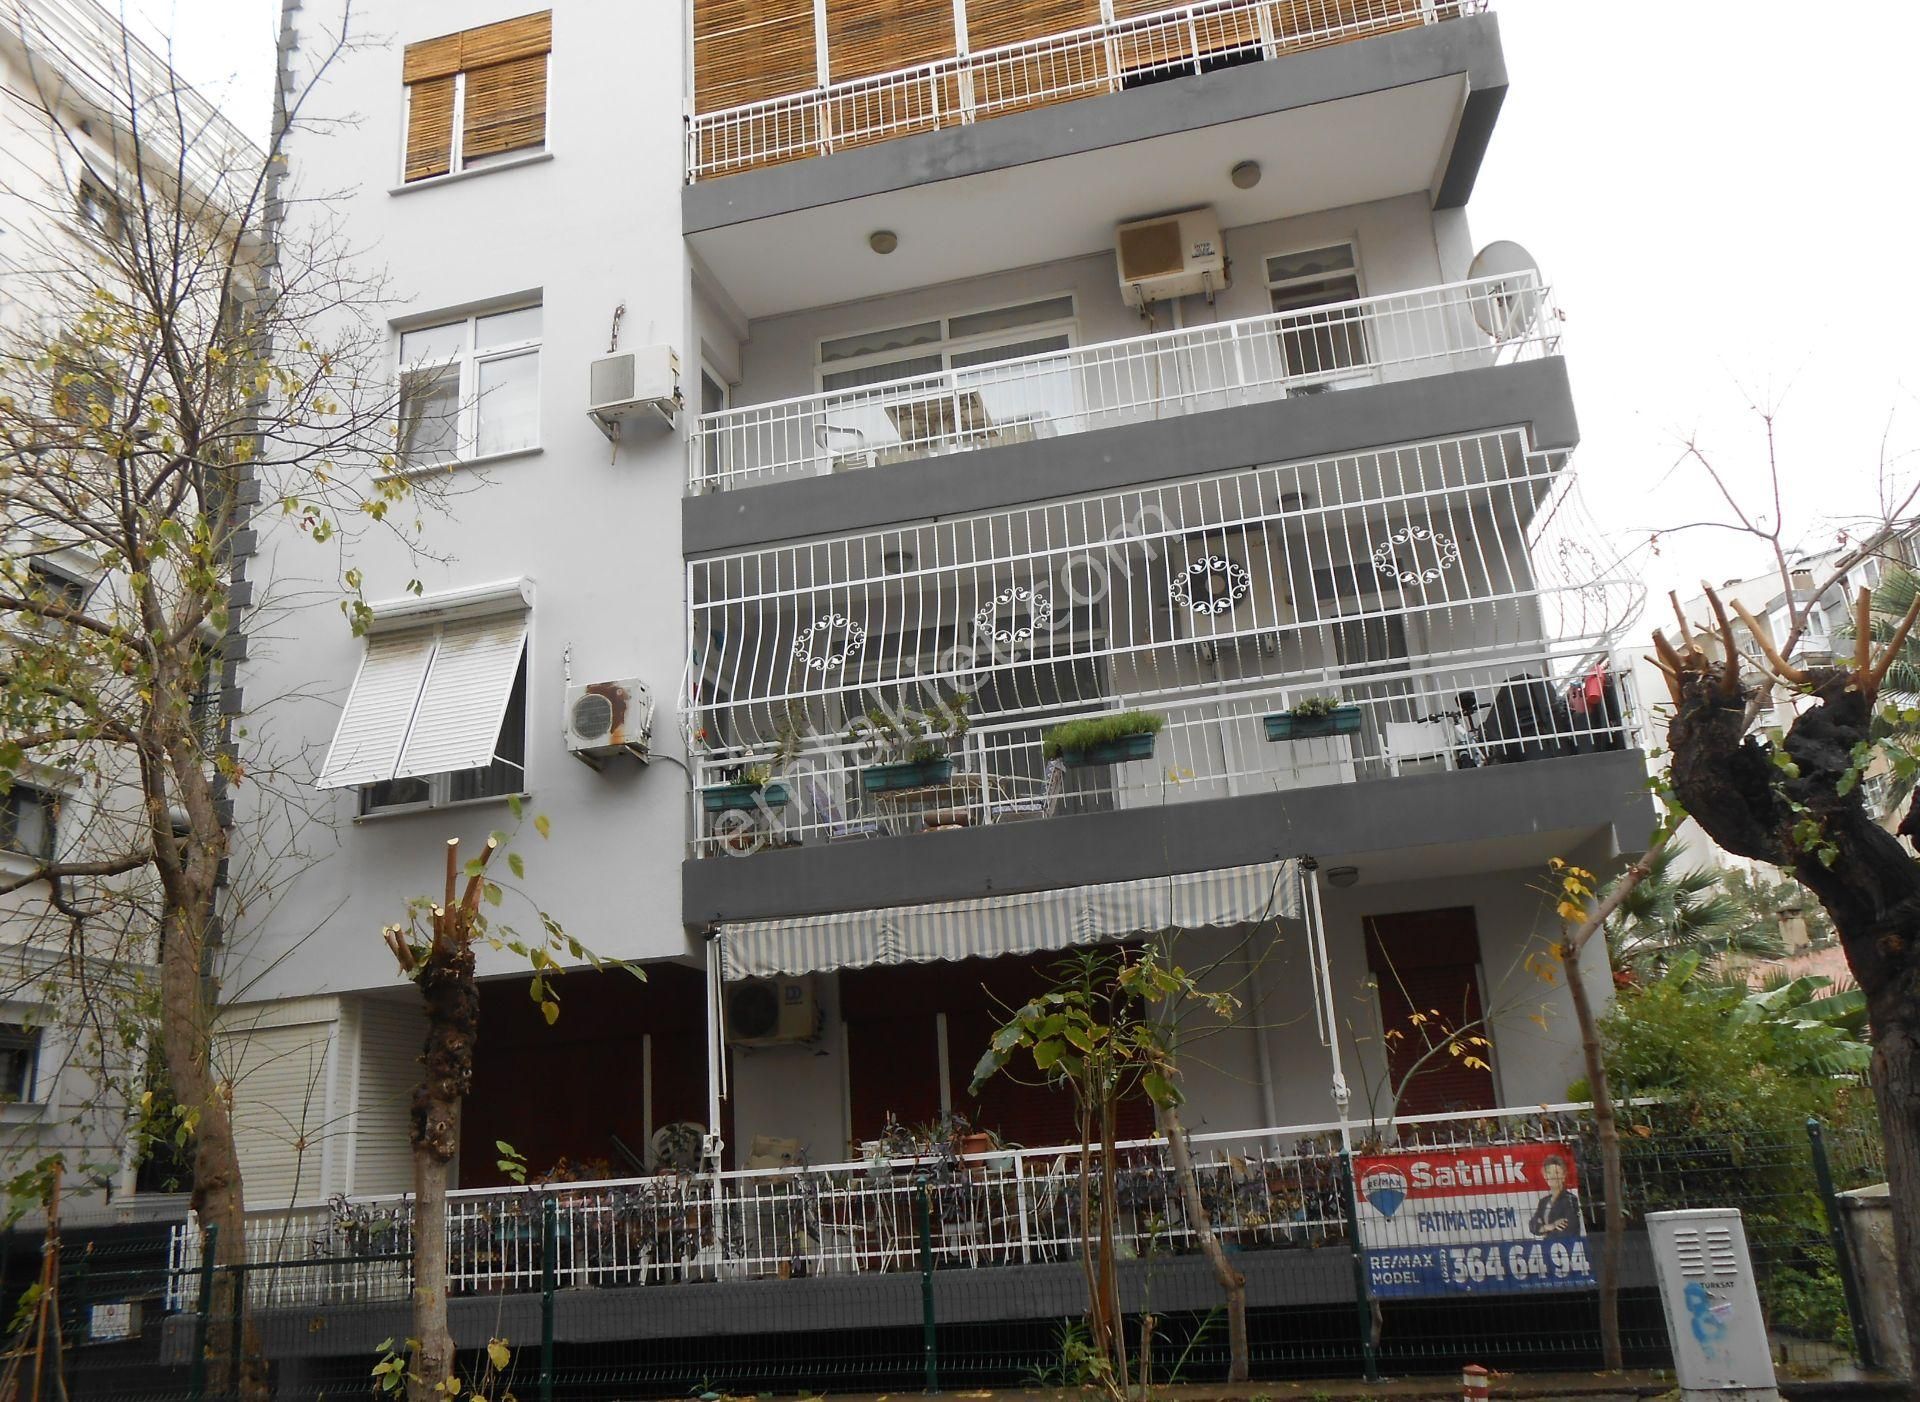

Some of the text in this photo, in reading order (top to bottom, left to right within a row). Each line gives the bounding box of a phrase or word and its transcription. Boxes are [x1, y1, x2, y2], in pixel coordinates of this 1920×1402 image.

[1411, 1155, 1528, 1189] Satılık
[1367, 1178, 1401, 1189] RE/MAX
[1469, 1206, 1517, 1230] ERDEM
[1370, 1254, 1433, 1270] RE/MAX
[1450, 1246, 1505, 1284] 364
[1509, 1244, 1547, 1281] 64
[1550, 1241, 1590, 1278] 94
[1372, 1271, 1420, 1285] MODEL
